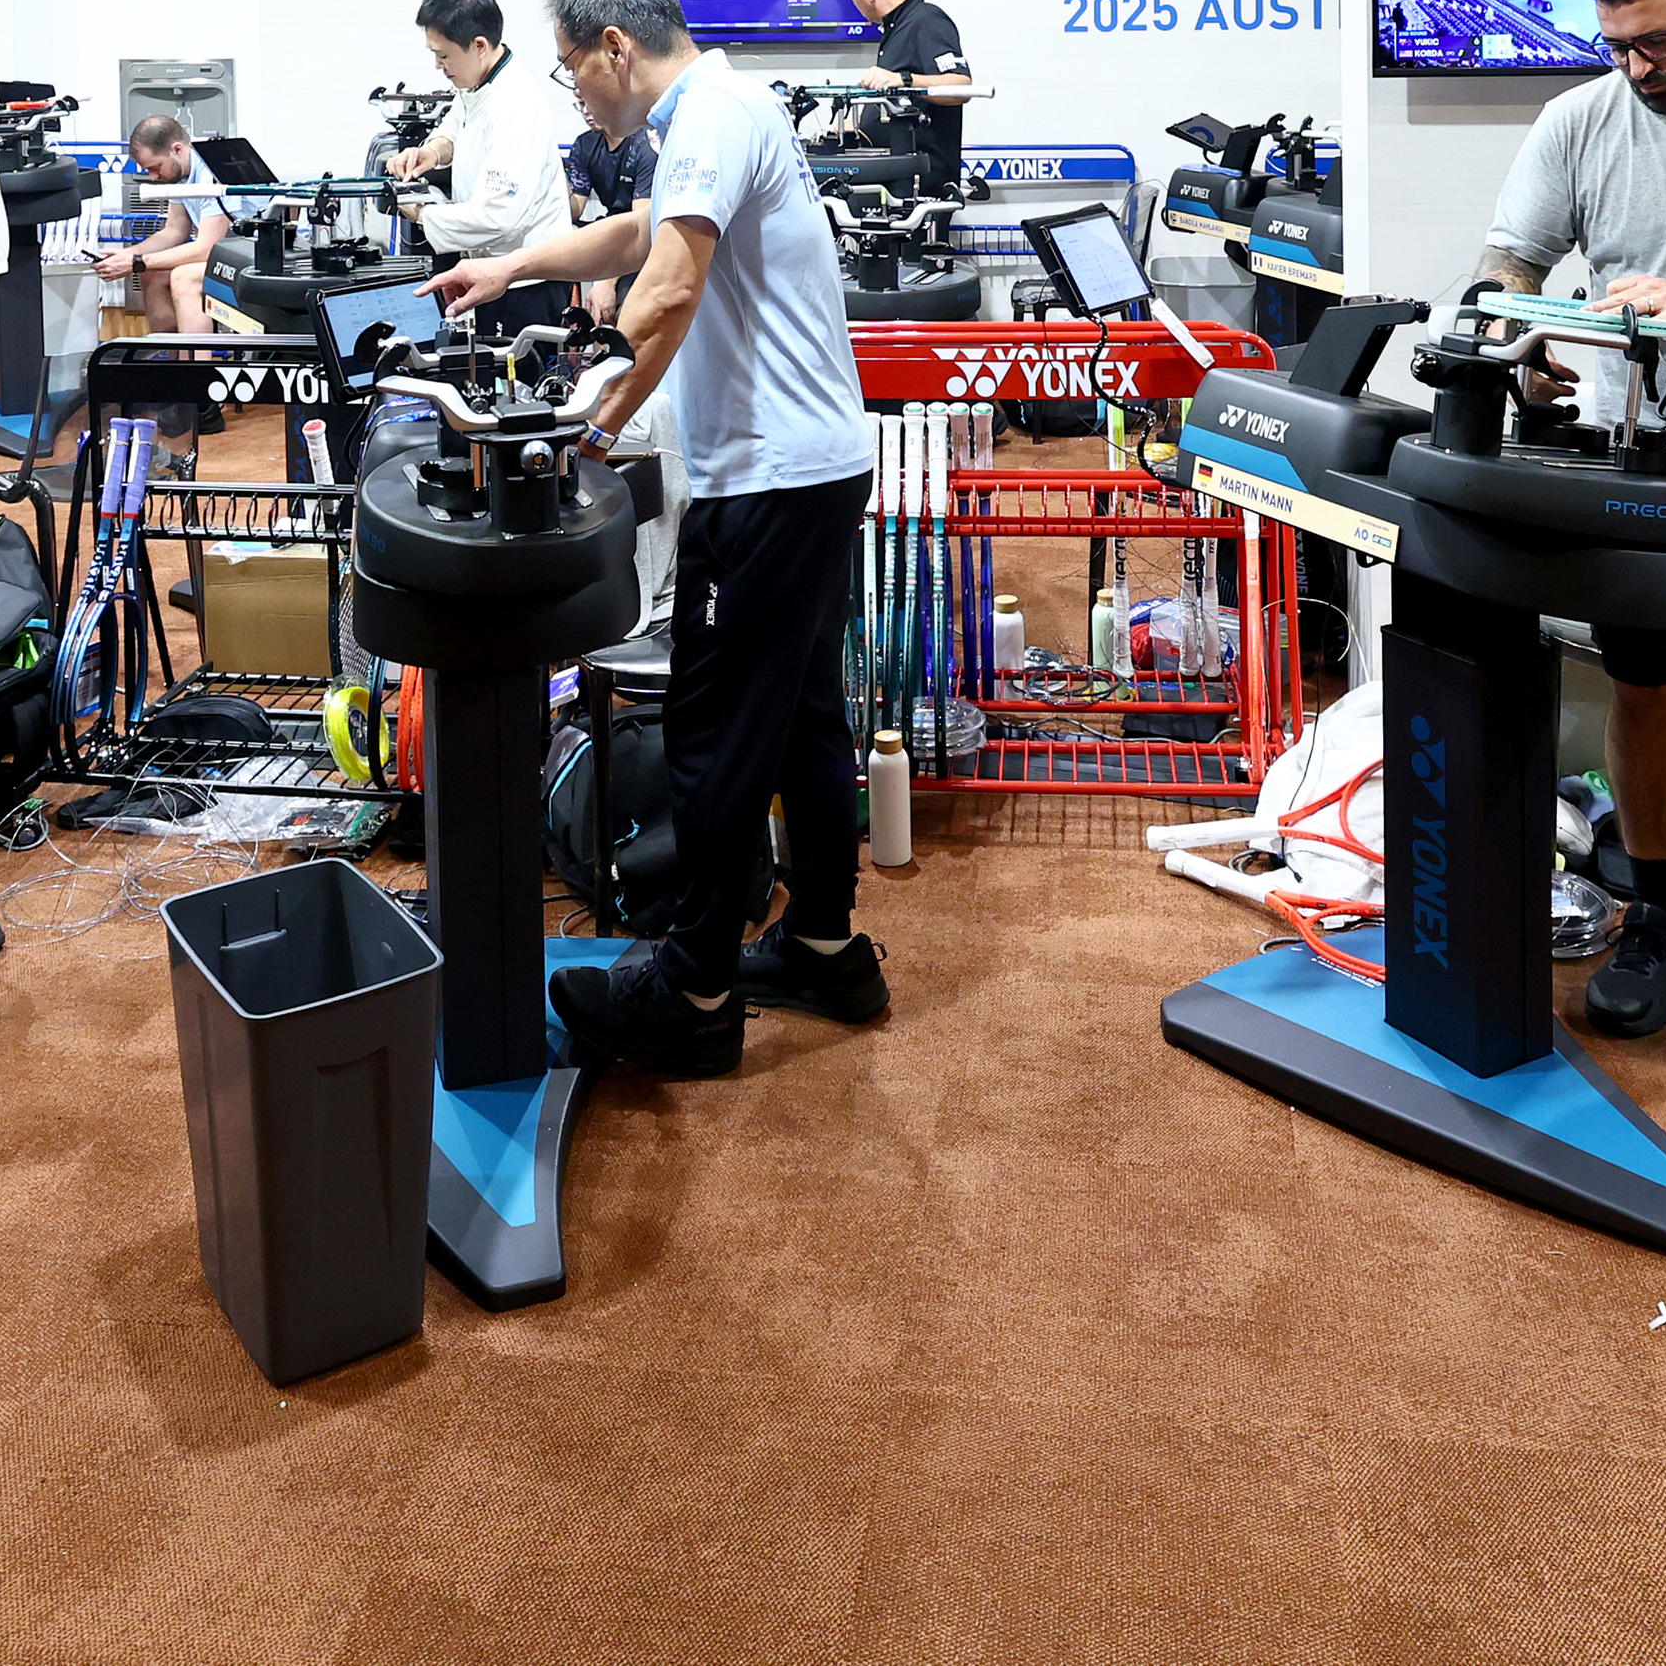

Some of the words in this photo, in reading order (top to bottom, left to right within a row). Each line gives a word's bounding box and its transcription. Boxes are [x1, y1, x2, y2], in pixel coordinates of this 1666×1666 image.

[847, 26, 863, 35] AO
[1414, 37, 1439, 46] VUKIC
[1474, 37, 1480, 46] 6
[1414, 49, 1443, 57] KORDA
[998, 159, 1063, 179] YONEX
[1191, 186, 1211, 200] YONEX
[1283, 222, 1310, 242] YONEX
[1019, 360, 1141, 398] YONEX
[1245, 410, 1291, 444] YONEX
[1219, 475, 1258, 500] MARTIN
[1260, 490, 1294, 514] MANN
[1354, 527, 1369, 541] AO
[706, 598, 717, 626] YONEX
[1412, 814, 1450, 972] YONEX
